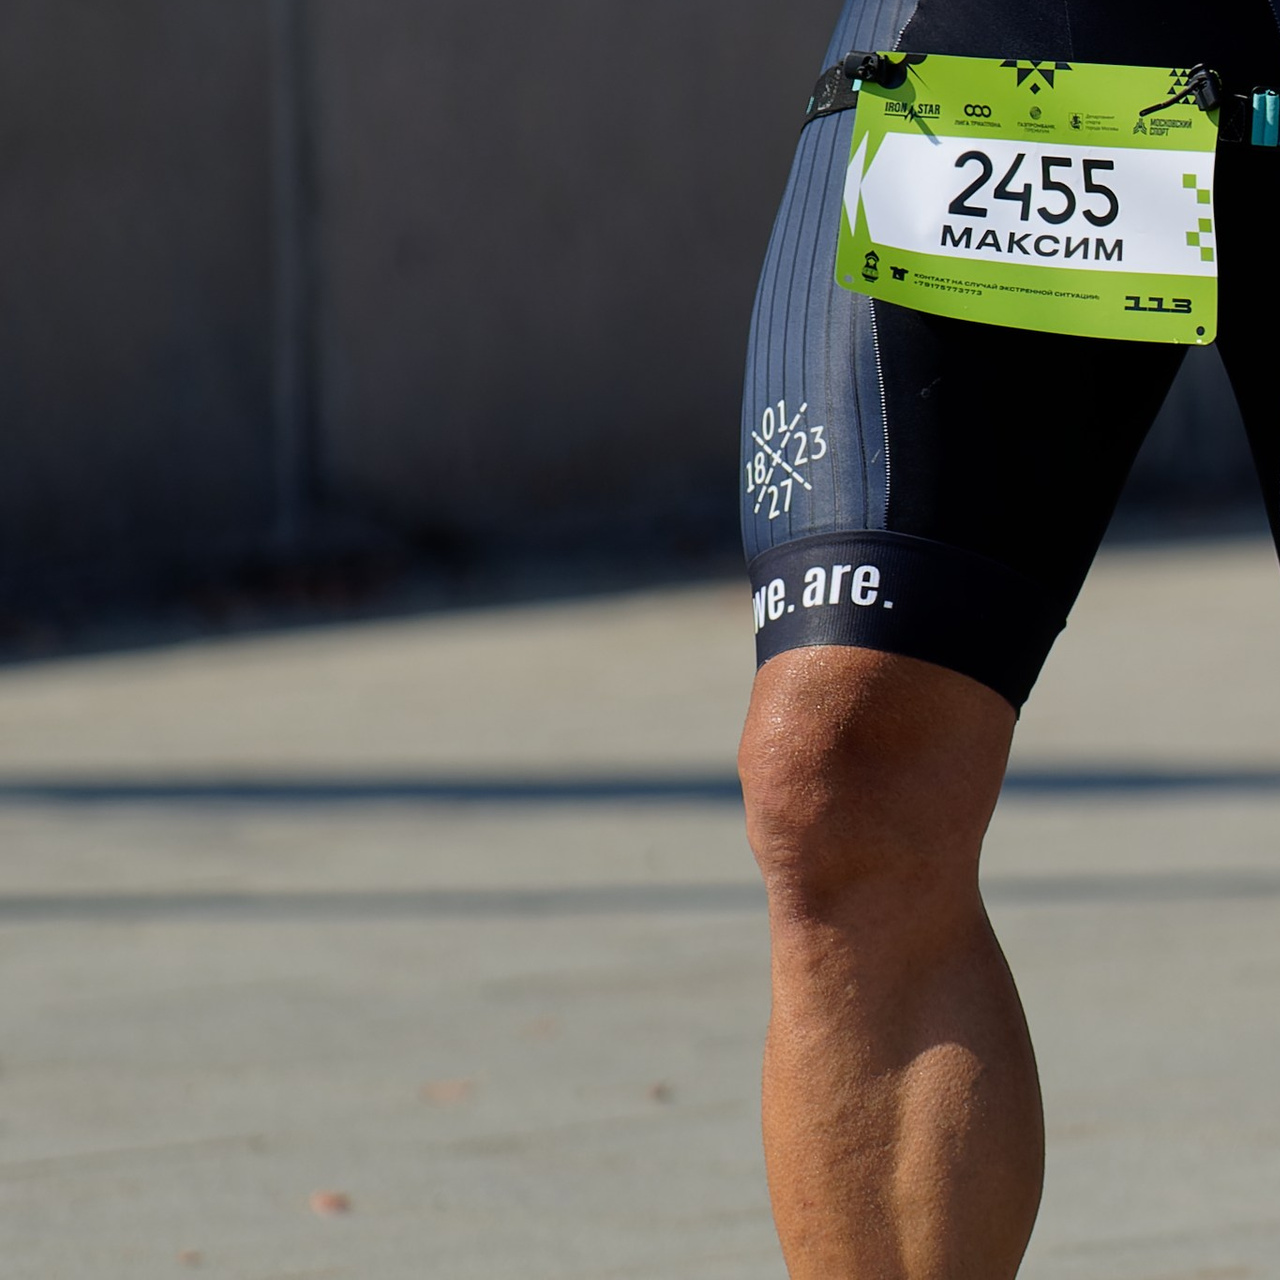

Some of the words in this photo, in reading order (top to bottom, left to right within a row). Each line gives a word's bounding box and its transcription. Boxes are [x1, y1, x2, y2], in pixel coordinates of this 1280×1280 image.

[885, 102, 907, 113] IRON
[918, 104, 941, 115] STAR
[948, 150, 1120, 227] 2455
[940, 225, 1124, 262] МАКСИМ
[914, 273, 950, 284] КОНТАКТ
[964, 281, 998, 290] СЛУЧАЙ
[1124, 296, 1192, 314] 113
[762, 399, 788, 440] 01
[745, 451, 767, 494] 18
[793, 425, 827, 466] 23
[767, 478, 793, 520] 27
[752, 578, 795, 634] we.
[802, 564, 894, 609] are.
